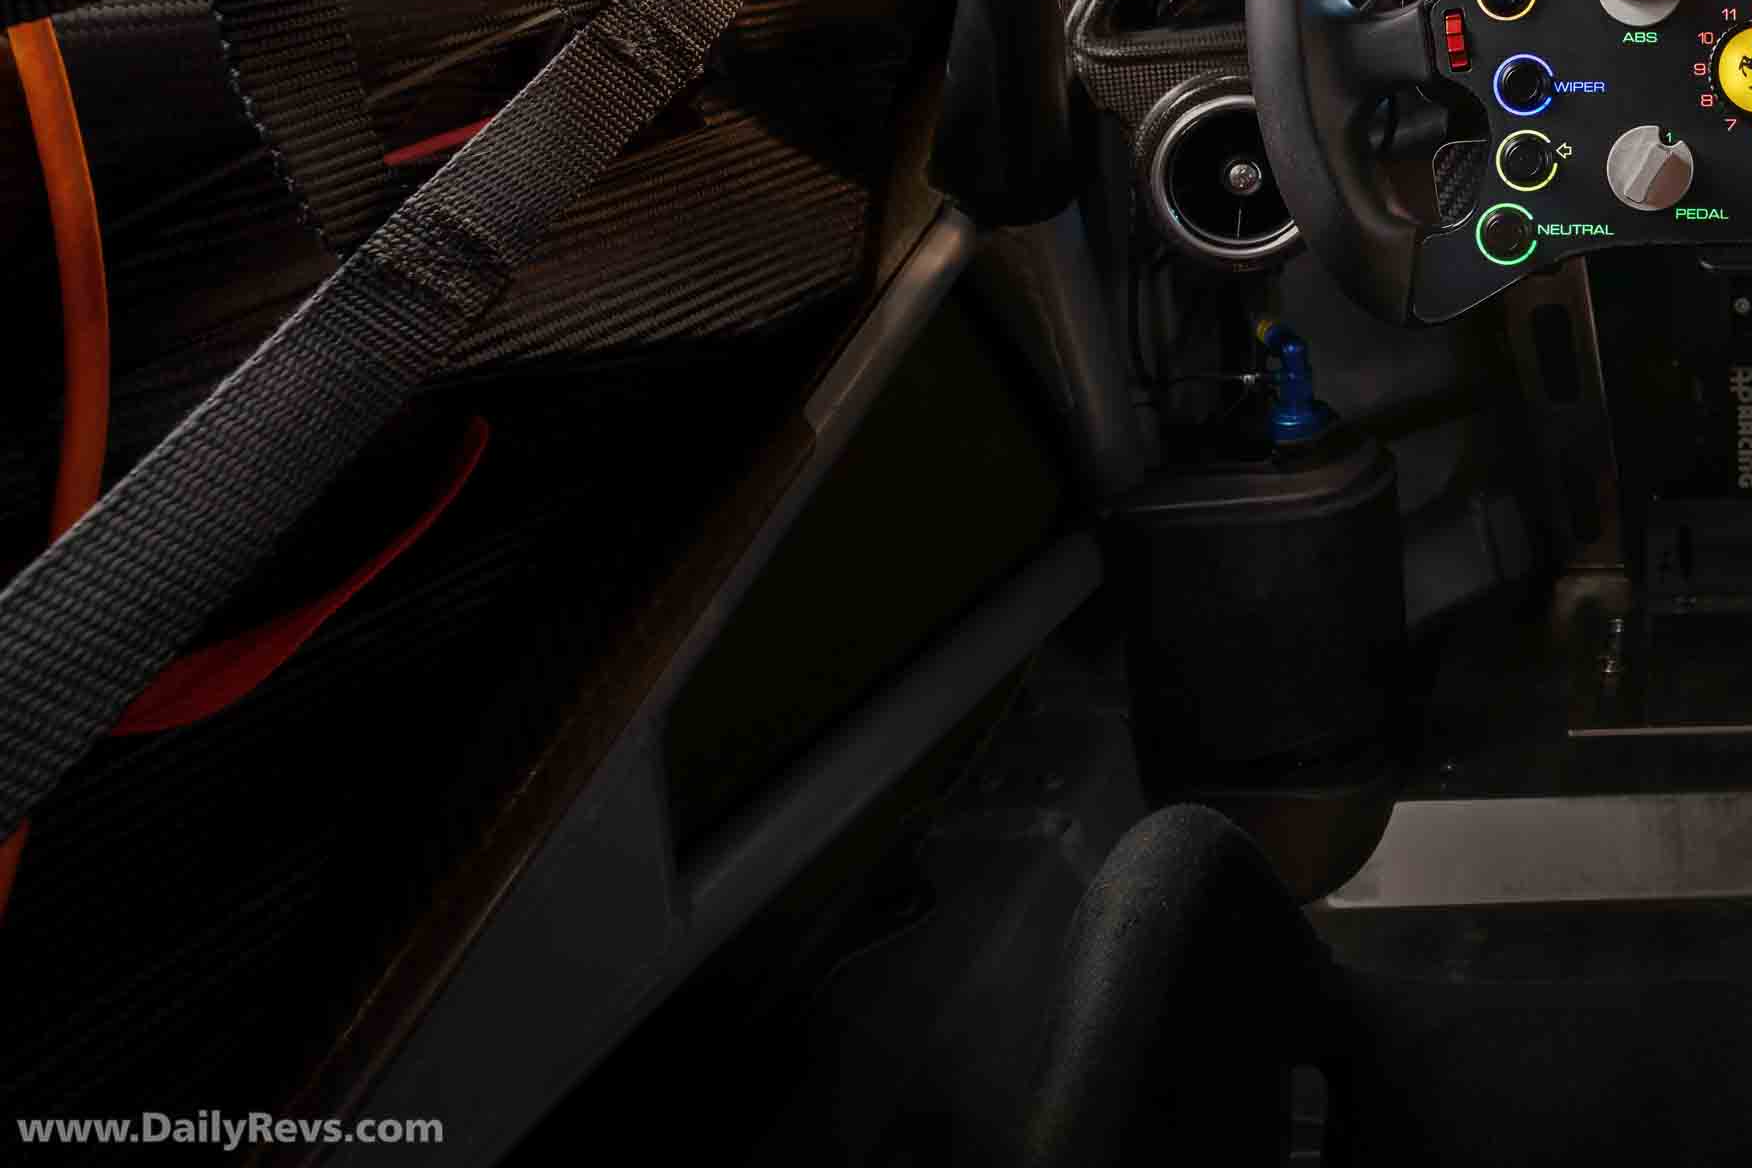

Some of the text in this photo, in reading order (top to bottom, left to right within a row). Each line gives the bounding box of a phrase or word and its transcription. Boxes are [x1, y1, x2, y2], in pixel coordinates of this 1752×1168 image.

[1722, 8, 1737, 21] 11
[1622, 31, 1658, 43] ABS
[1698, 32, 1714, 44] 10
[1694, 63, 1706, 75] 9
[1554, 81, 1605, 93] WIPER
[1701, 95, 1713, 107] 8
[1725, 118, 1737, 131] 7
[1666, 131, 1673, 143] 1
[1675, 208, 1729, 220] PEDAL
[1537, 224, 1615, 236] NEUTRAL
